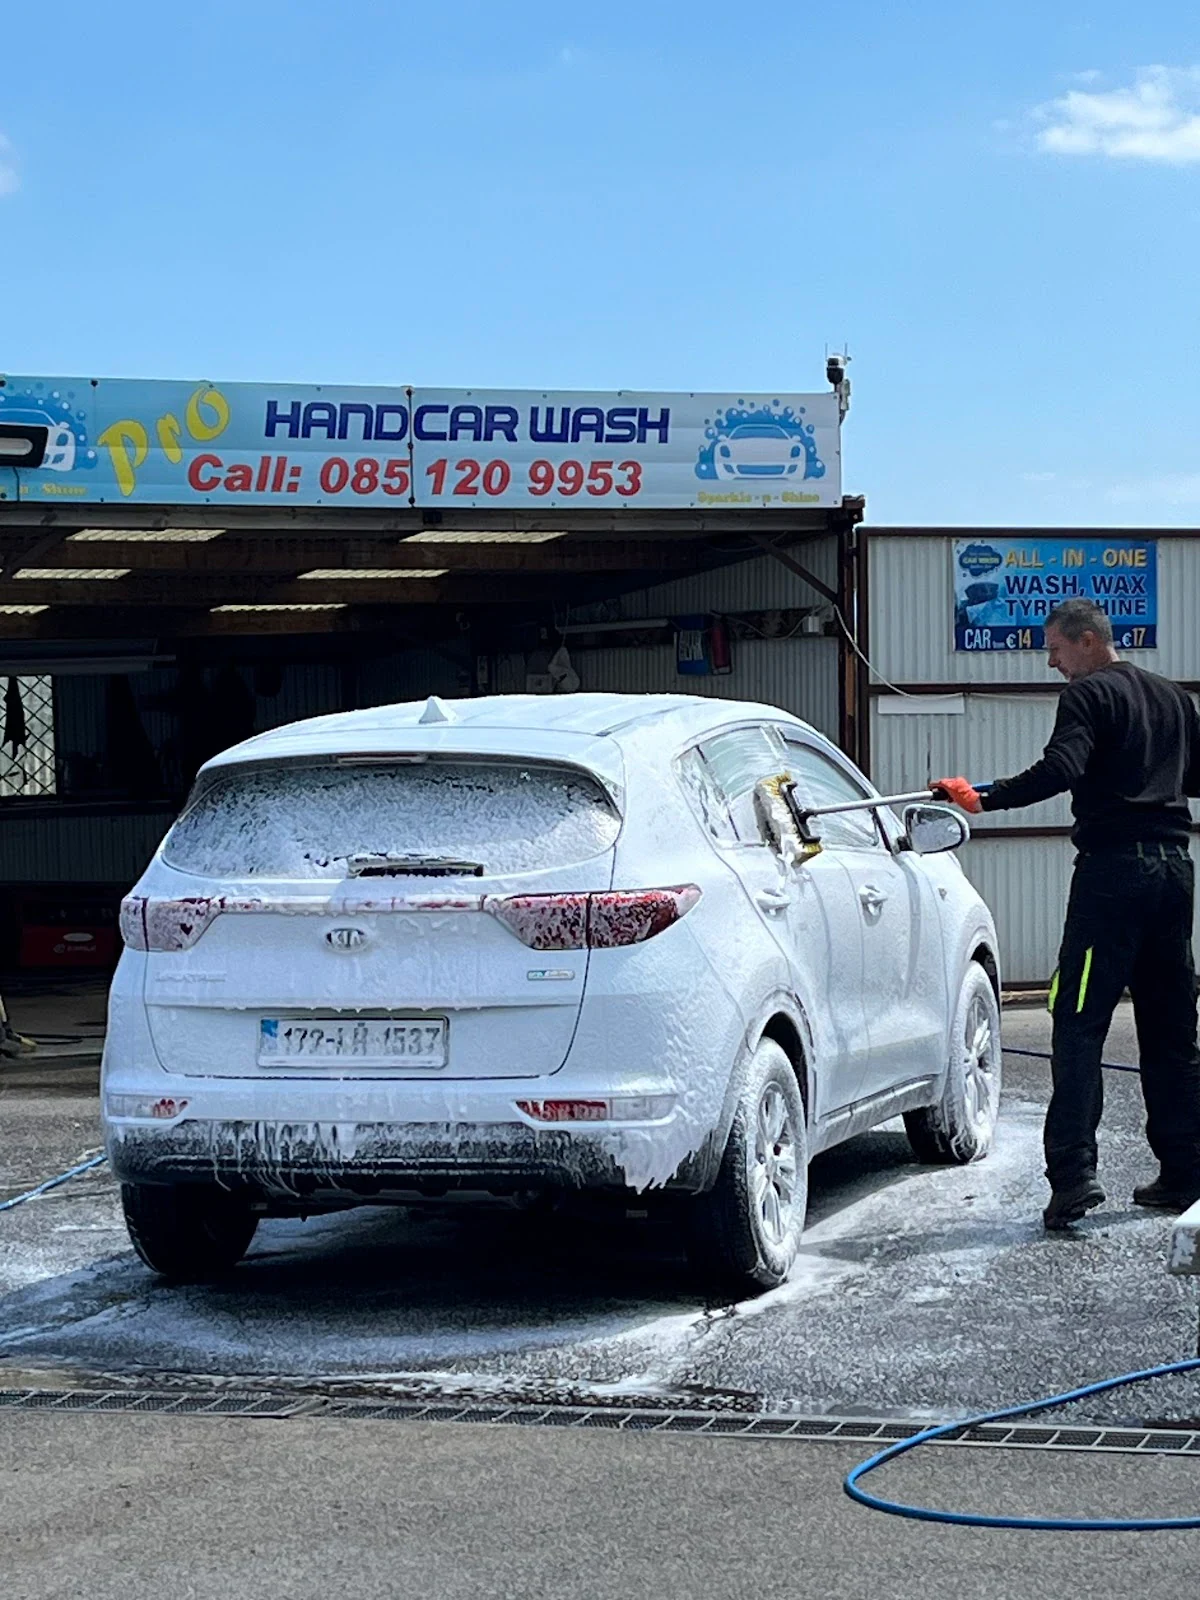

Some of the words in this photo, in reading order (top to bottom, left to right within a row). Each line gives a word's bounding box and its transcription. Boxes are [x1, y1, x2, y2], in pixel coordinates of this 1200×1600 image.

[265, 400, 406, 440] HAND
[413, 404, 519, 443] CAR
[529, 406, 670, 444] WASH
[188, 454, 301, 492] Call:
[319, 458, 412, 495] 085
[426, 460, 510, 496] 120
[527, 461, 642, 497] 9953
[1005, 550, 1044, 568] ALL
[1063, 549, 1084, 567] IN
[1102, 549, 1147, 567] ONE
[1005, 575, 1085, 597] WASH,
[1092, 575, 1145, 595] WAX
[1094, 599, 1146, 616] HINE
[965, 629, 991, 649] CAR
